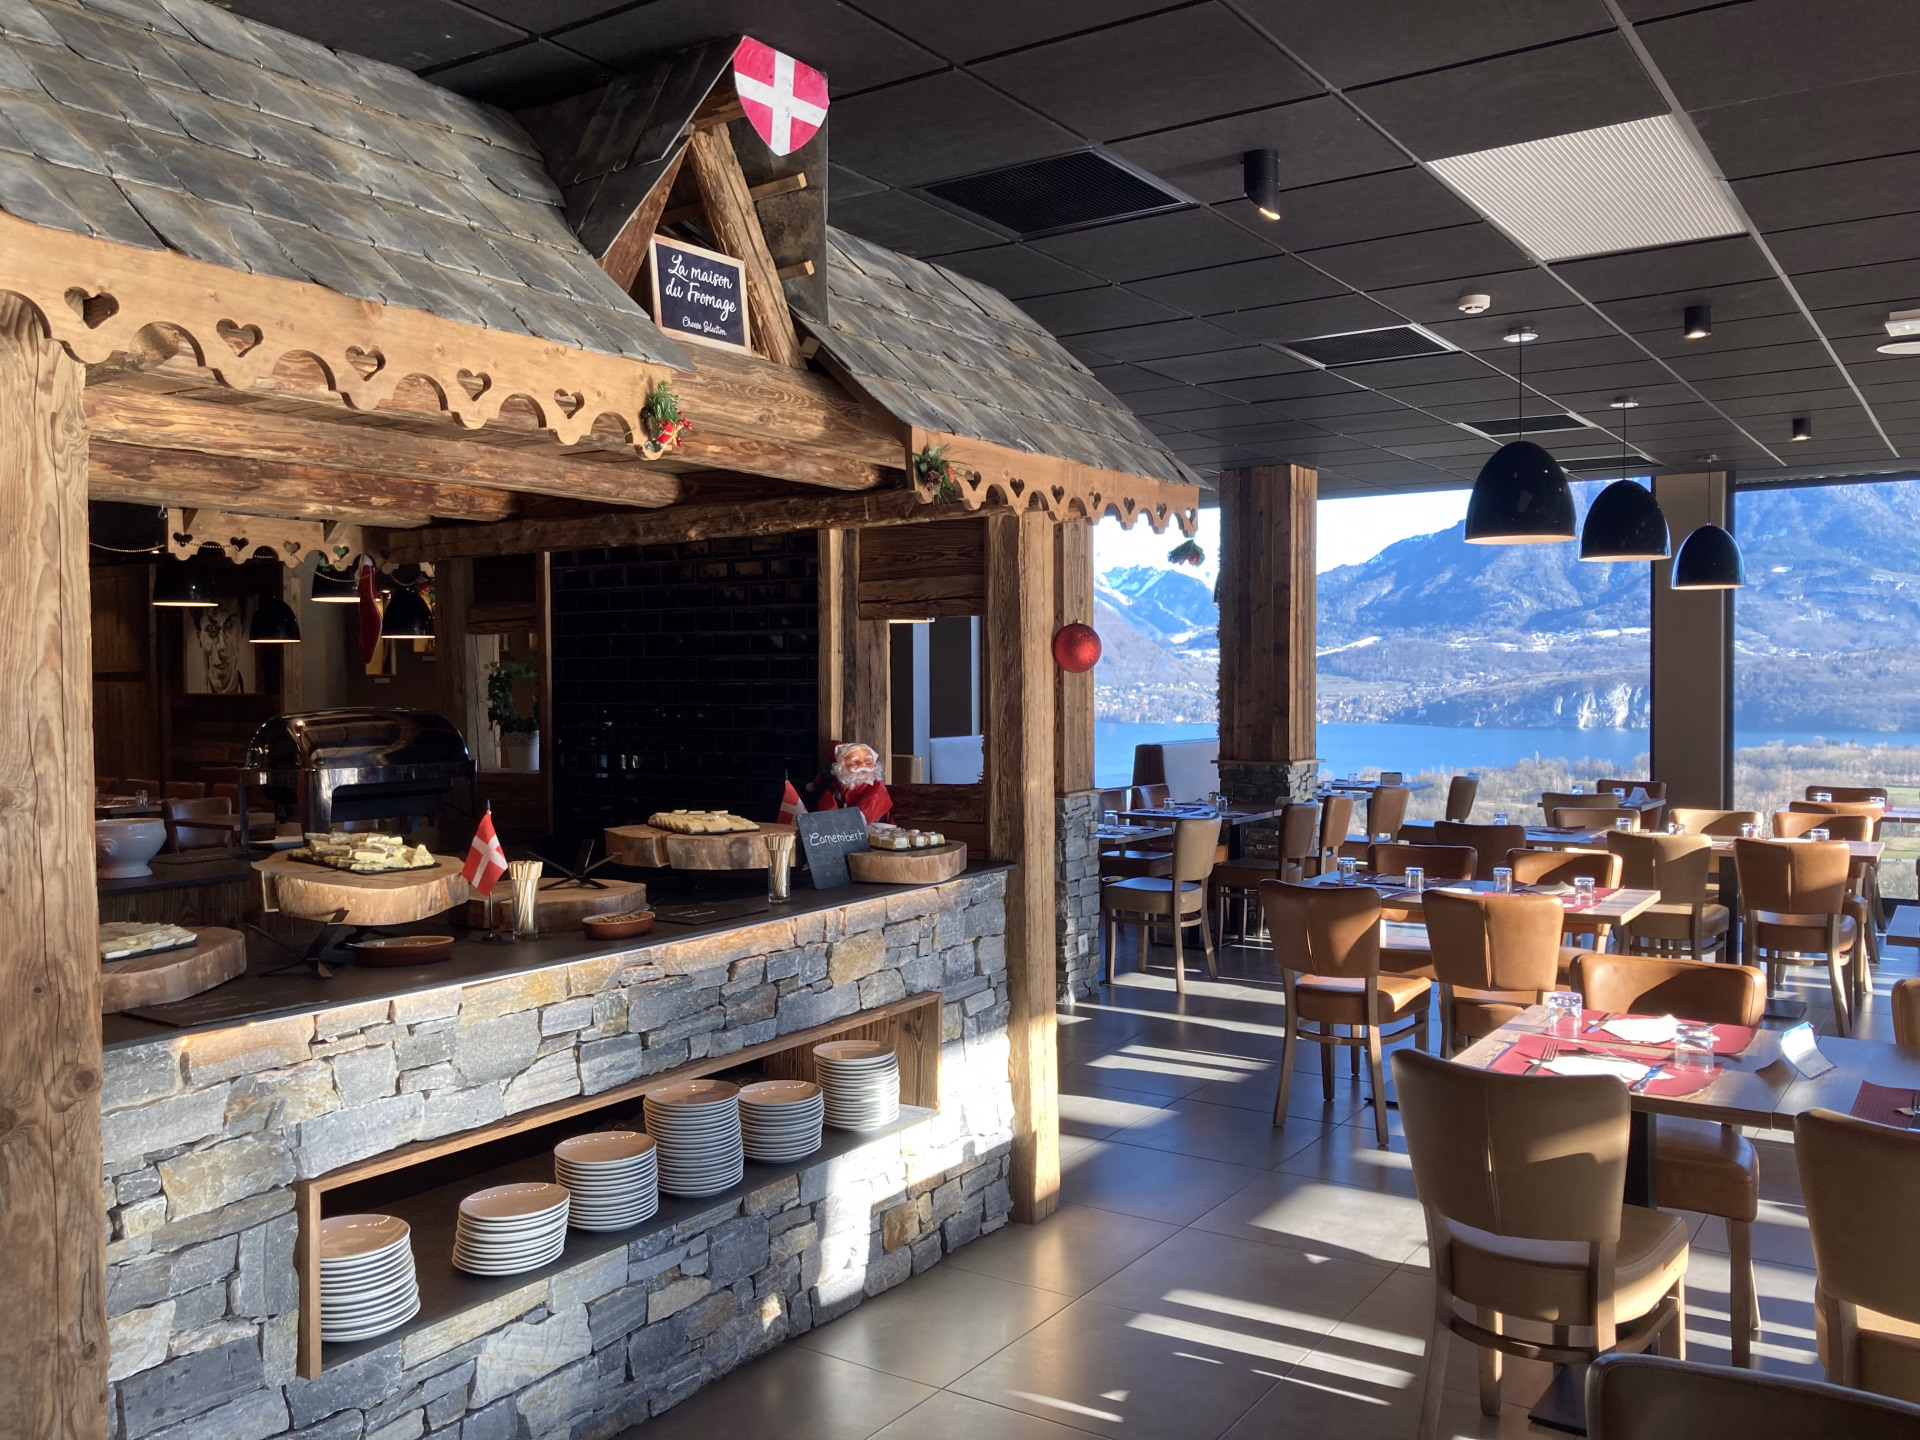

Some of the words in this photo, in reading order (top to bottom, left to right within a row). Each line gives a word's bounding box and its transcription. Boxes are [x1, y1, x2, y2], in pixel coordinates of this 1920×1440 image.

[668, 254, 690, 283] La
[690, 266, 733, 290] maison
[665, 277, 684, 298] du
[687, 282, 737, 322] Fromage
[682, 315, 703, 330] Cheese
[703, 320, 728, 336] Selection
[809, 829, 865, 847] Camembert
